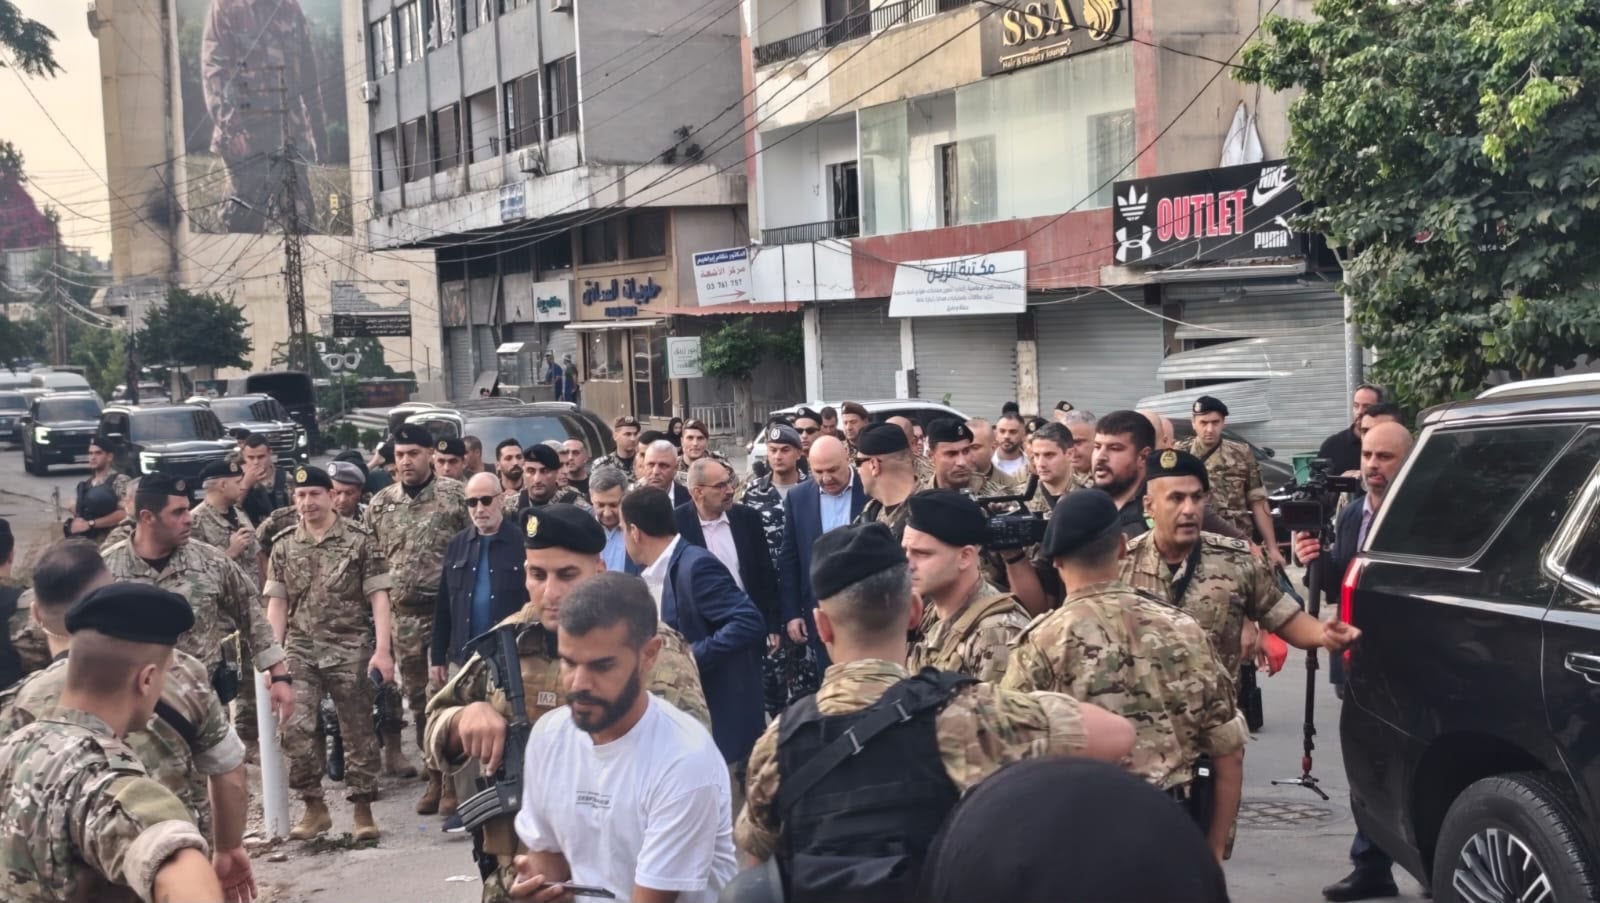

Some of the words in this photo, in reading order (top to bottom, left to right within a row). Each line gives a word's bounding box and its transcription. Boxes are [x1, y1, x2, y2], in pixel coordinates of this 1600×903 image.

[1003, 0, 1076, 46] SSA
[1002, 59, 1016, 69] Hair
[1023, 53, 1044, 64] Beauty
[1258, 165, 1288, 188] NIKE
[1157, 189, 1247, 242] OUTLET
[1254, 230, 1287, 249] PUMA
[959, 260, 996, 281] مكتبة
